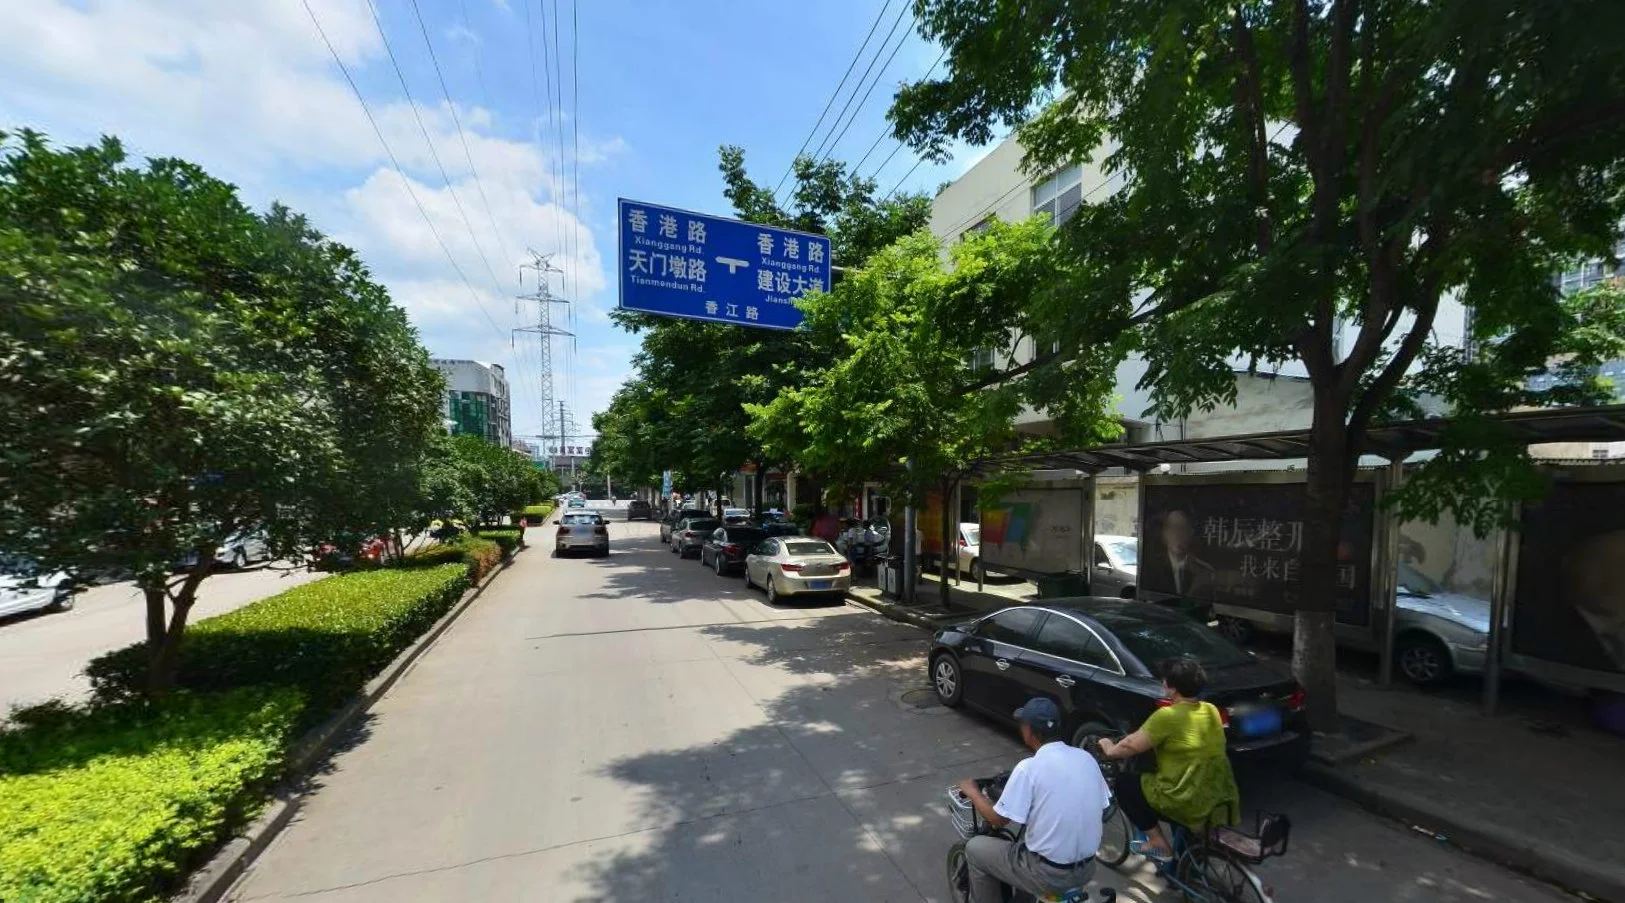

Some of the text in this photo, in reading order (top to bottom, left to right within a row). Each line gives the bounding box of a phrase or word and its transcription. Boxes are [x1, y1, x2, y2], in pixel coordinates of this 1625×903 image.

[629, 209, 706, 244] 香港路
[635, 235, 687, 253] Xianggang
[757, 233, 824, 264] 香港路
[629, 249, 707, 282] 天门墩路
[761, 257, 807, 272] Xianggang
[630, 274, 689, 291] Tianmendun
[757, 269, 824, 295] 建设大道
[705, 300, 759, 320] 香江路
